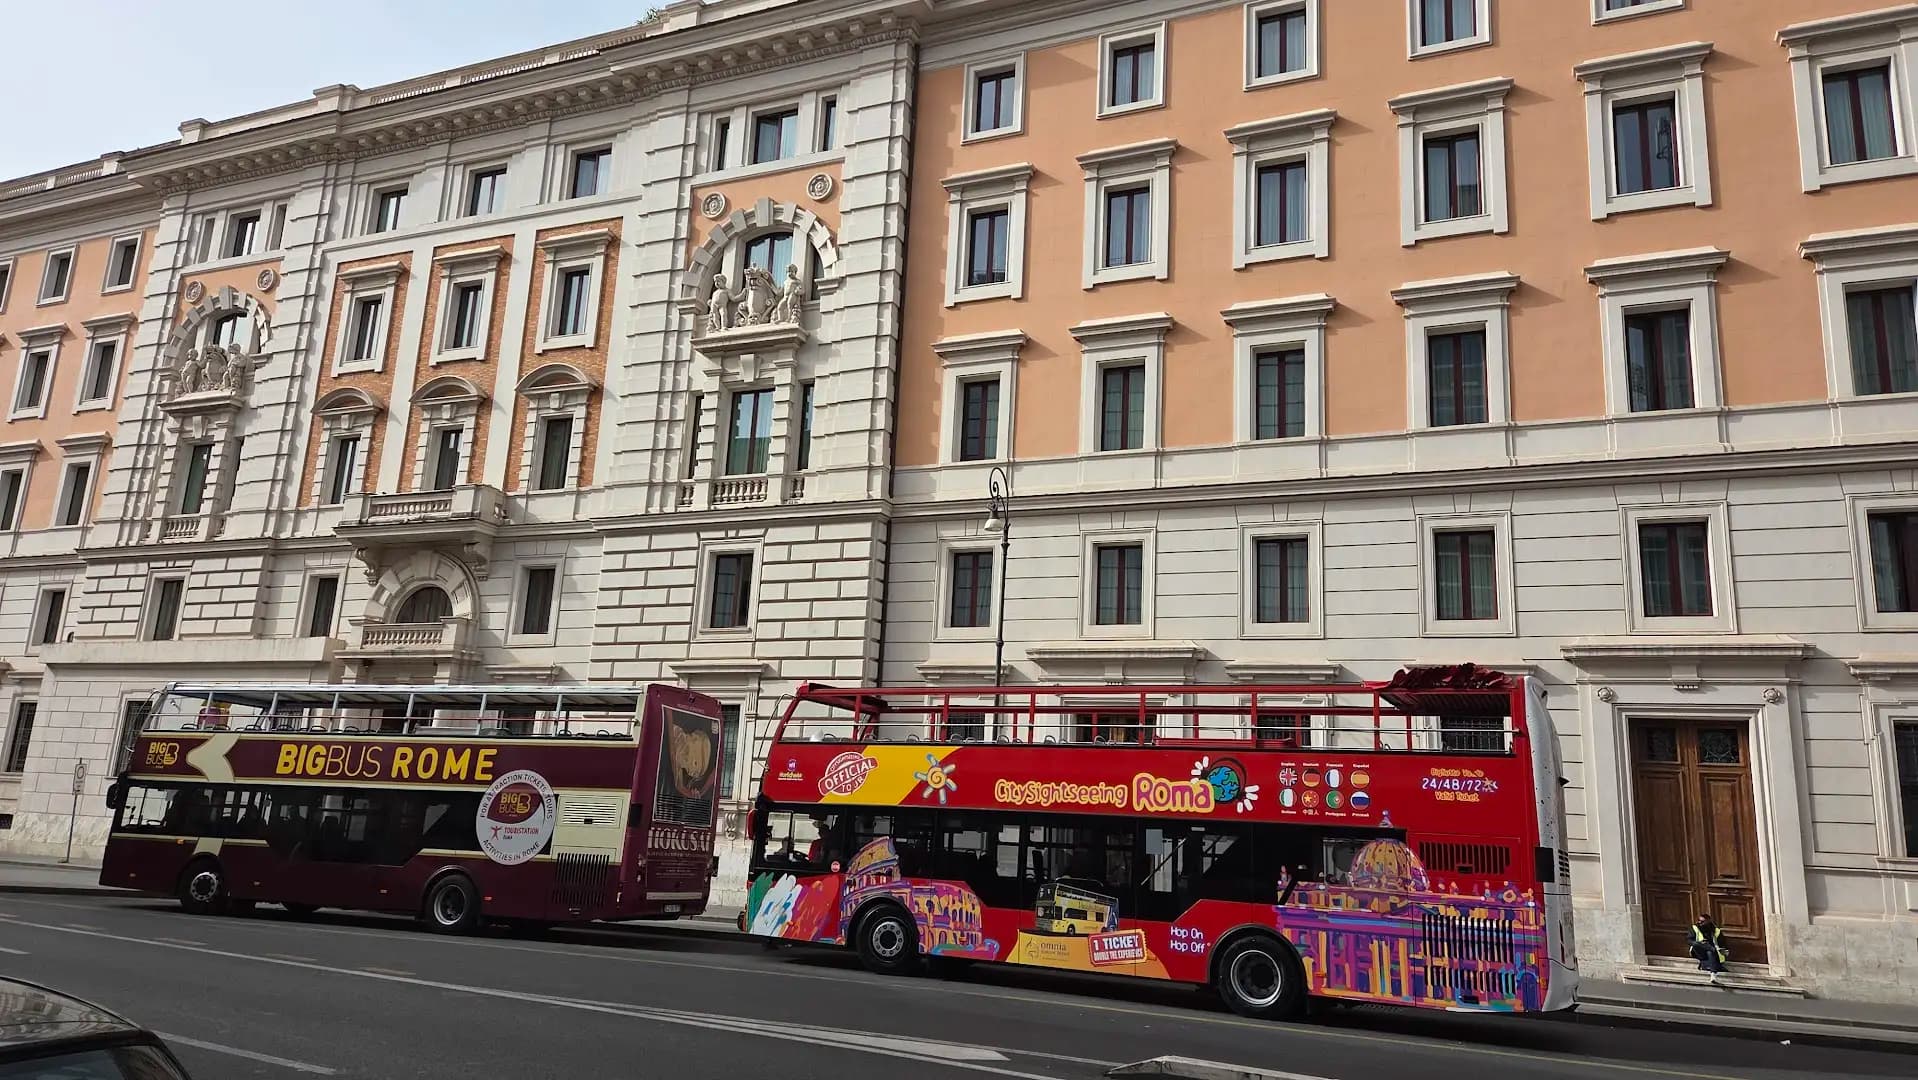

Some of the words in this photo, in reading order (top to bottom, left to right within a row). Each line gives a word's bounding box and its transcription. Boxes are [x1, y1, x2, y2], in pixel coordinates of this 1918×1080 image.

[149, 742, 167, 754] BIG
[146, 754, 164, 765] BUS
[391, 746, 498, 780] ROME
[824, 759, 875, 790] OFFICIAL
[487, 773, 523, 802] ATTRACTION
[1133, 773, 1216, 813] Roma
[500, 792, 518, 804] BIG
[499, 803, 516, 813] BUS
[482, 839, 513, 861] ACTIVITIES
[521, 841, 541, 857] ROME
[1170, 925, 1189, 939] Hop
[1190, 927, 1204, 940] On
[1093, 939, 1099, 951] 1
[1102, 935, 1139, 950] TICKET
[1170, 939, 1189, 952] Hop
[1190, 941, 1206, 953] Off
